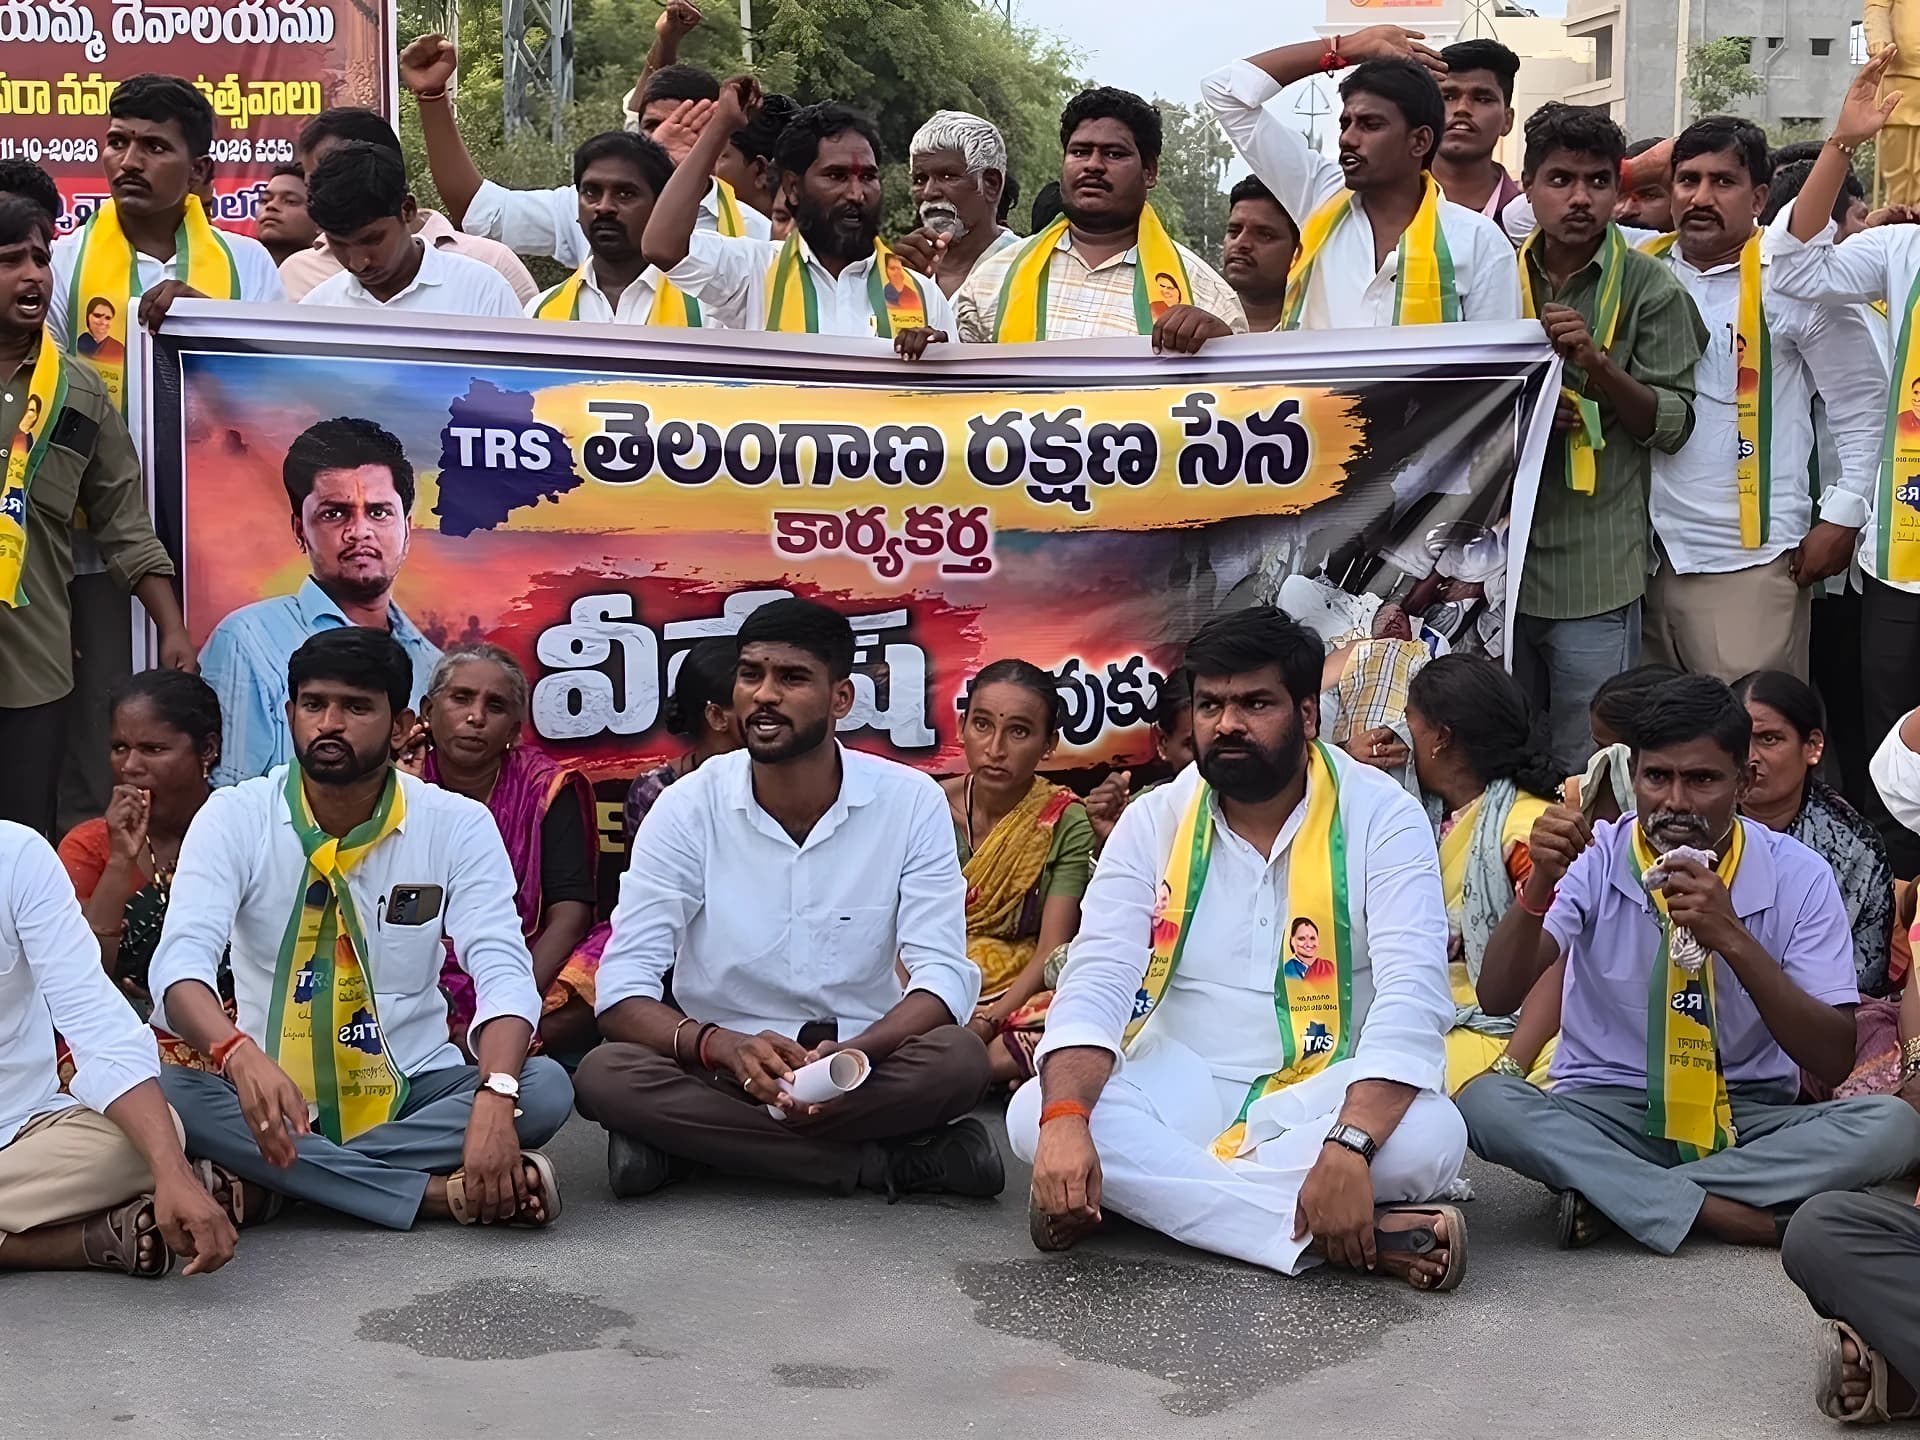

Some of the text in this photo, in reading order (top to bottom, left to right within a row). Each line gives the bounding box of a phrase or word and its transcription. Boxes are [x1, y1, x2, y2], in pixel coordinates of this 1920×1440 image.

[450, 427, 552, 471] TRS
[583, 393, 1311, 511] తెలంగాణ రక్షణ సేన
[774, 506, 991, 579] కార్యకర్త
[1302, 1034, 1334, 1052] TRS
